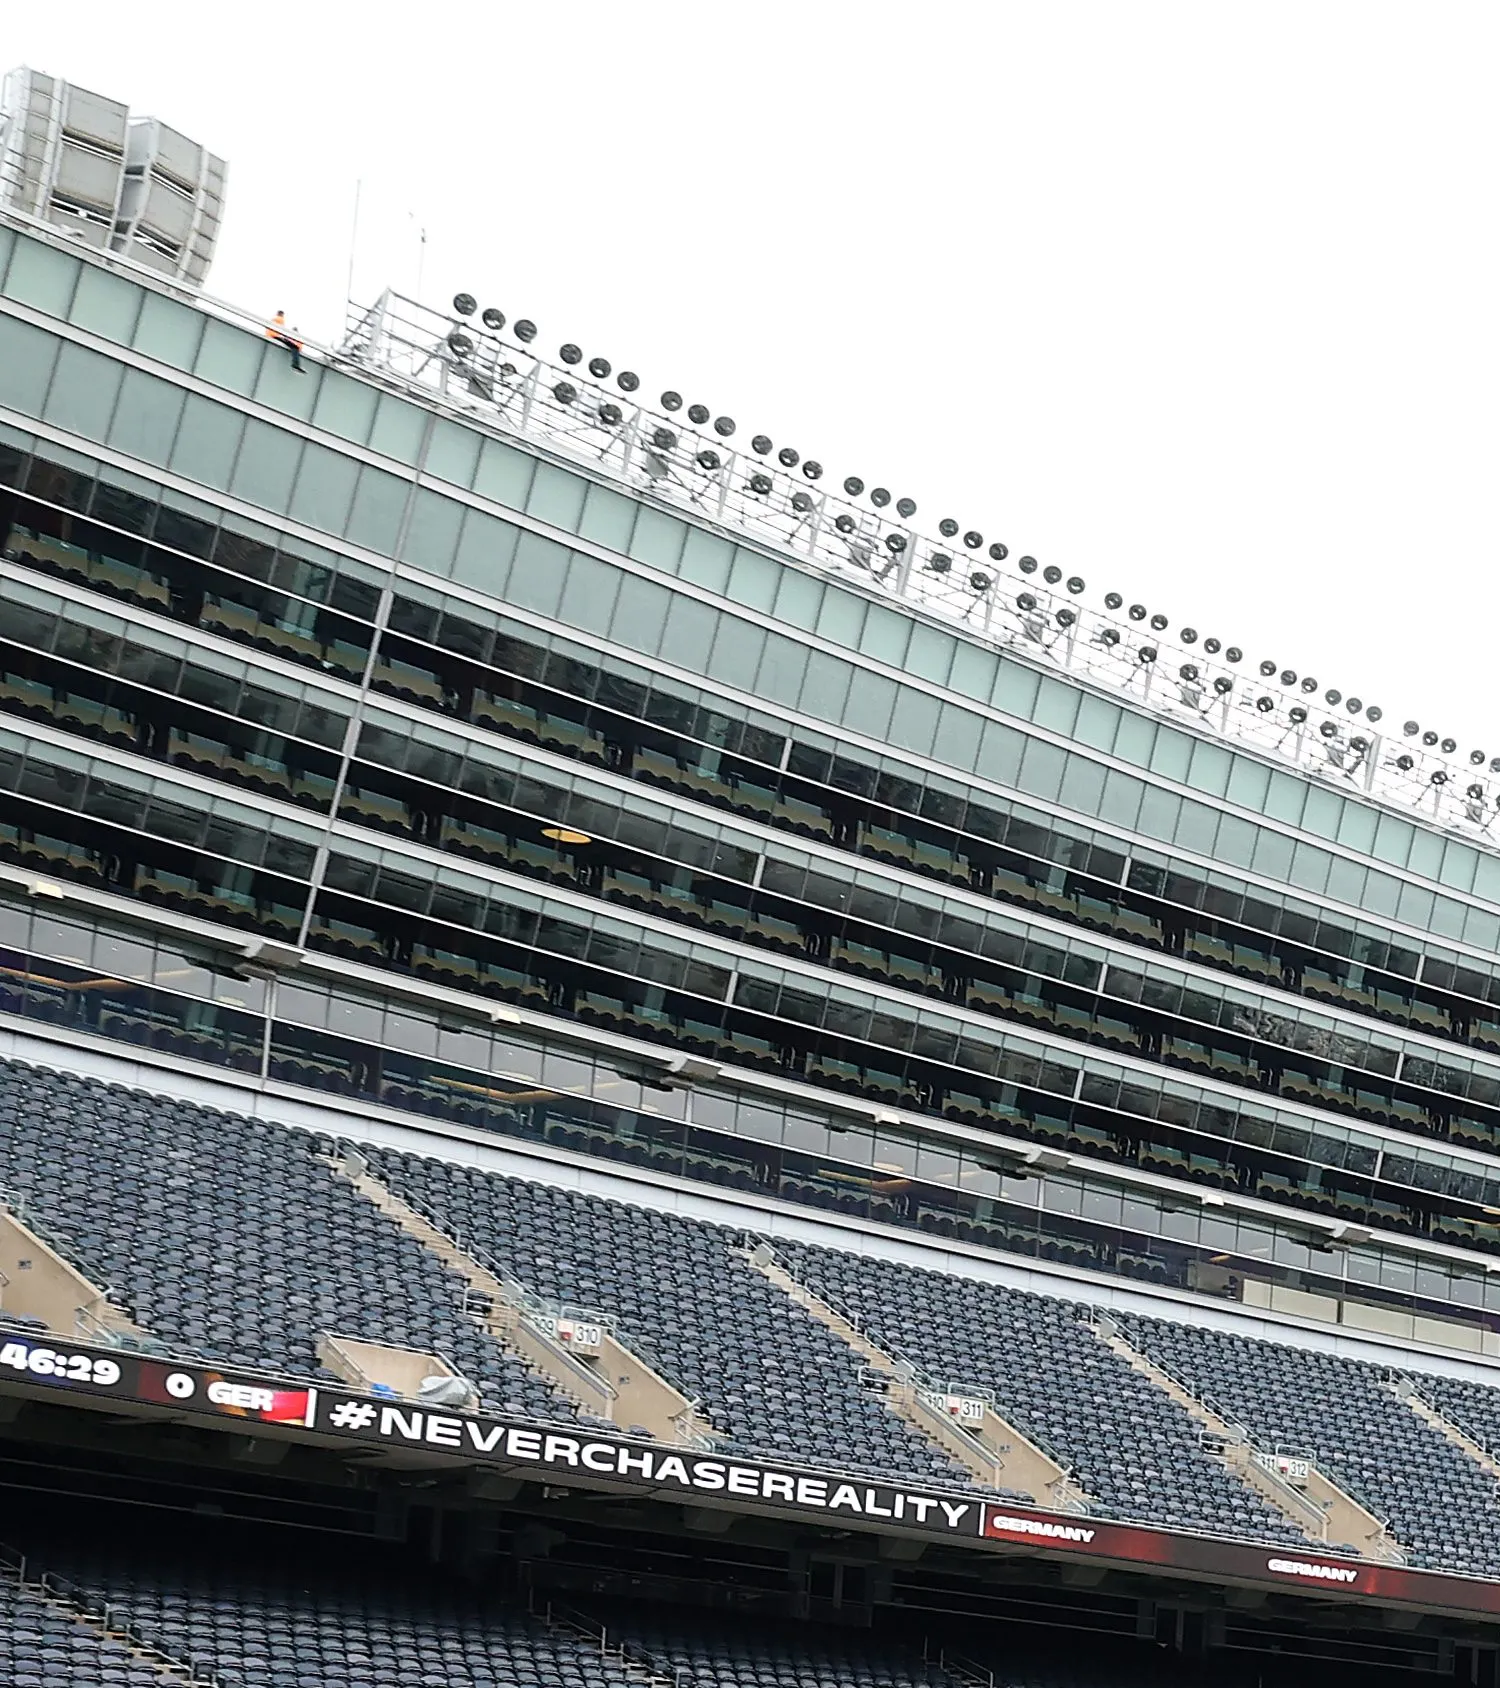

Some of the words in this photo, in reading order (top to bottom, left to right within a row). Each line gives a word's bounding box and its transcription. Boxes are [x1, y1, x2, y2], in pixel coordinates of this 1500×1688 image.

[576, 1326, 598, 1344] 310
[0, 1342, 121, 1385] 46:29
[207, 1382, 273, 1411] GER
[963, 1401, 982, 1417] 311
[329, 1401, 969, 1528] #NEVERCHASEREALITY
[1291, 1464, 1307, 1477] 312
[992, 1515, 1096, 1543] GERMANY
[1268, 1558, 1358, 1583] GERMANY
